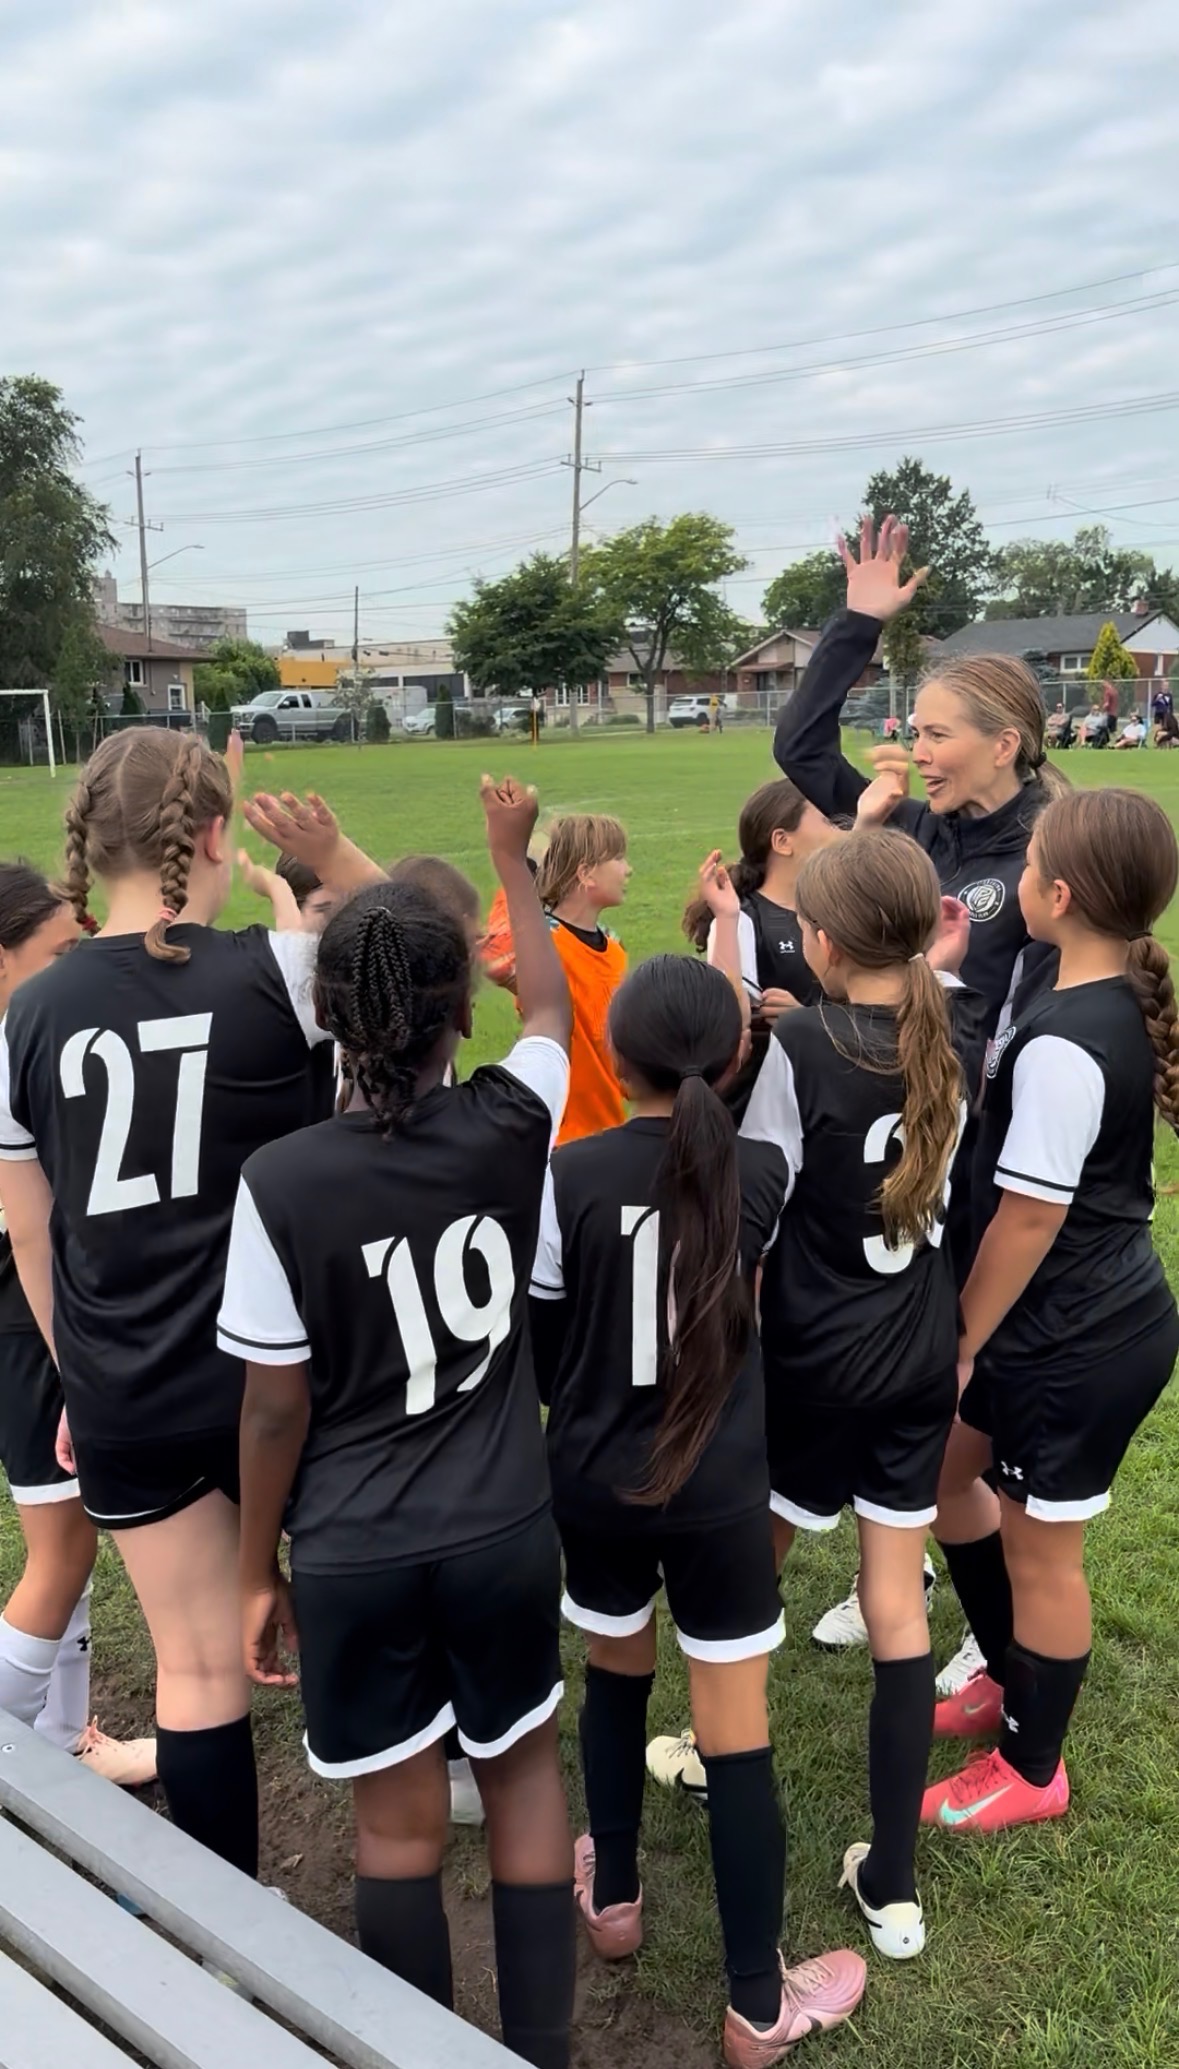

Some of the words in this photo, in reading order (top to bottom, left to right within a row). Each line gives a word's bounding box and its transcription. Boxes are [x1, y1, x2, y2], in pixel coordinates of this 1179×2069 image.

[59, 1012, 213, 1217] 27
[863, 1099, 968, 1274] 3
[361, 1214, 516, 1416] 19
